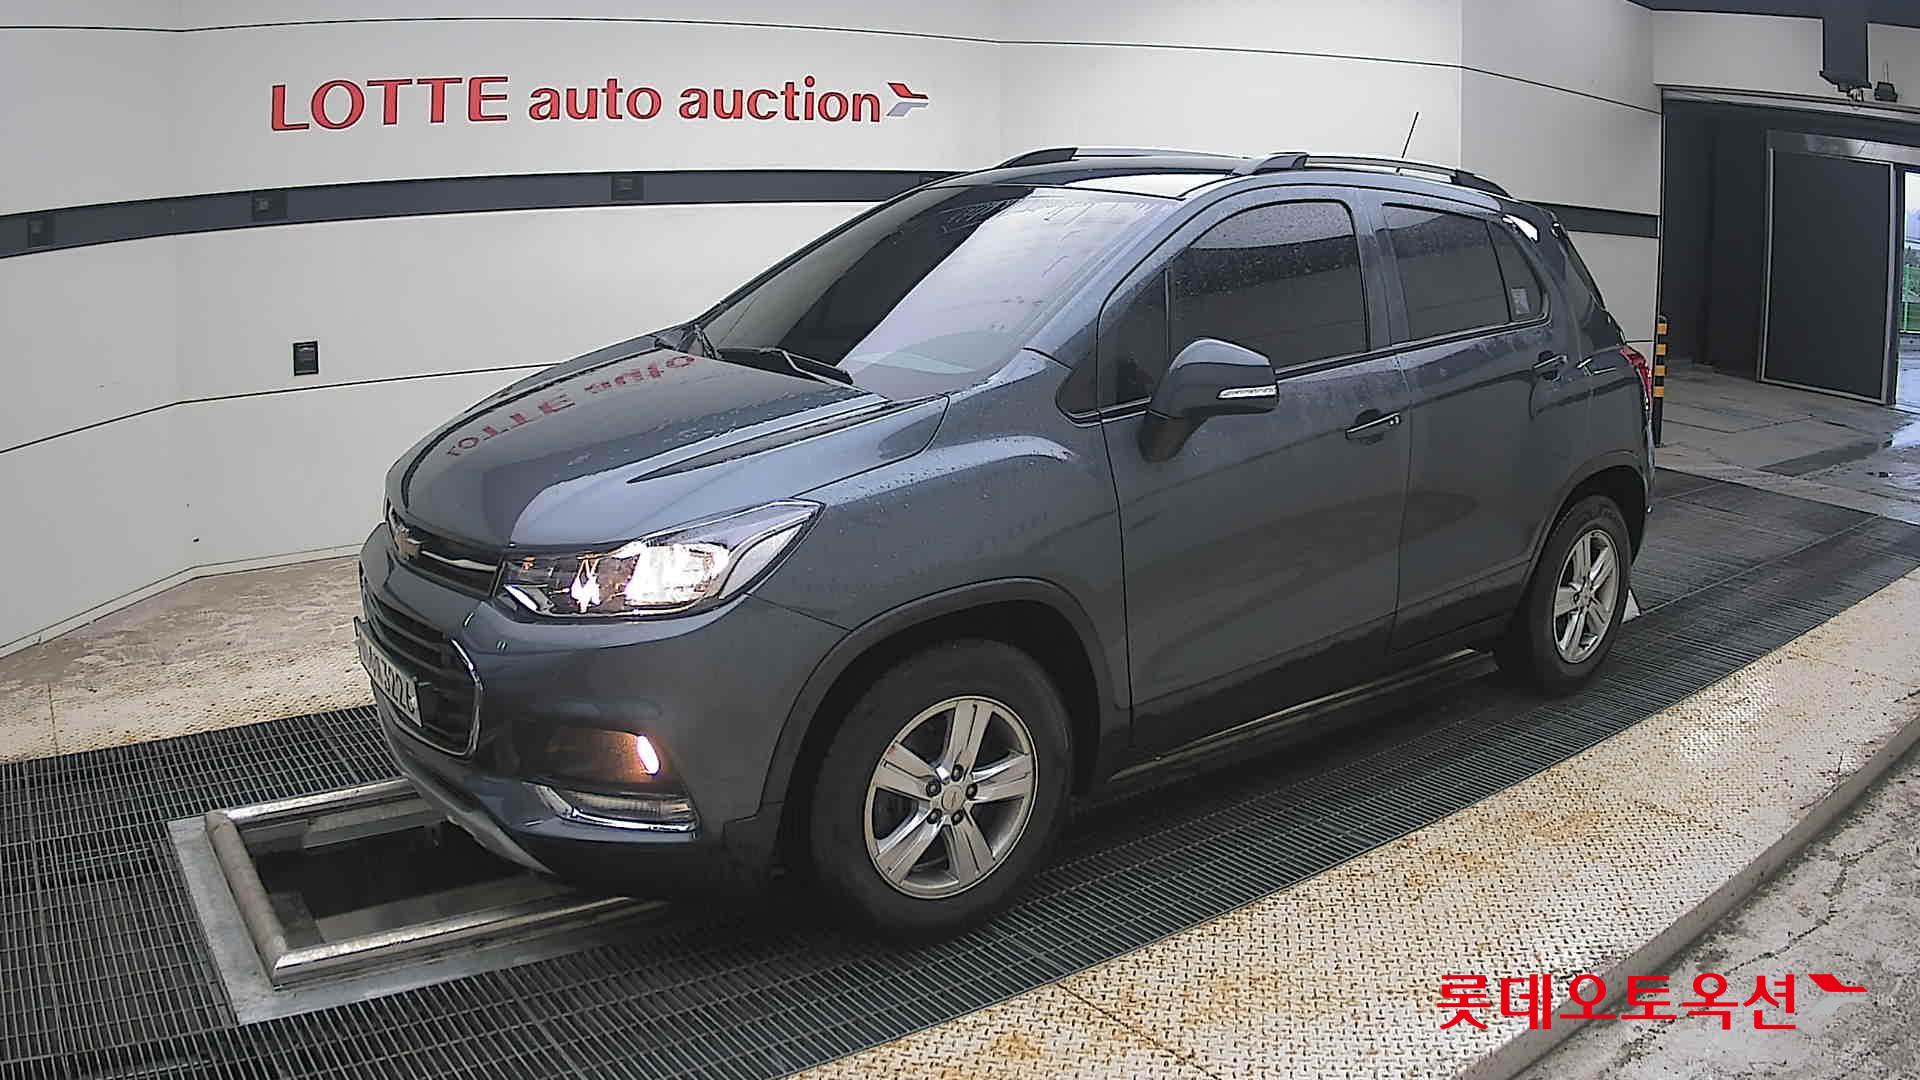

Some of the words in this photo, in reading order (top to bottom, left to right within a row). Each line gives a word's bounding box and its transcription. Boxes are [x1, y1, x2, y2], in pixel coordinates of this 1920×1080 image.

[270, 75, 508, 132] LOTTE
[529, 78, 662, 121] auto
[679, 75, 881, 123] auction
